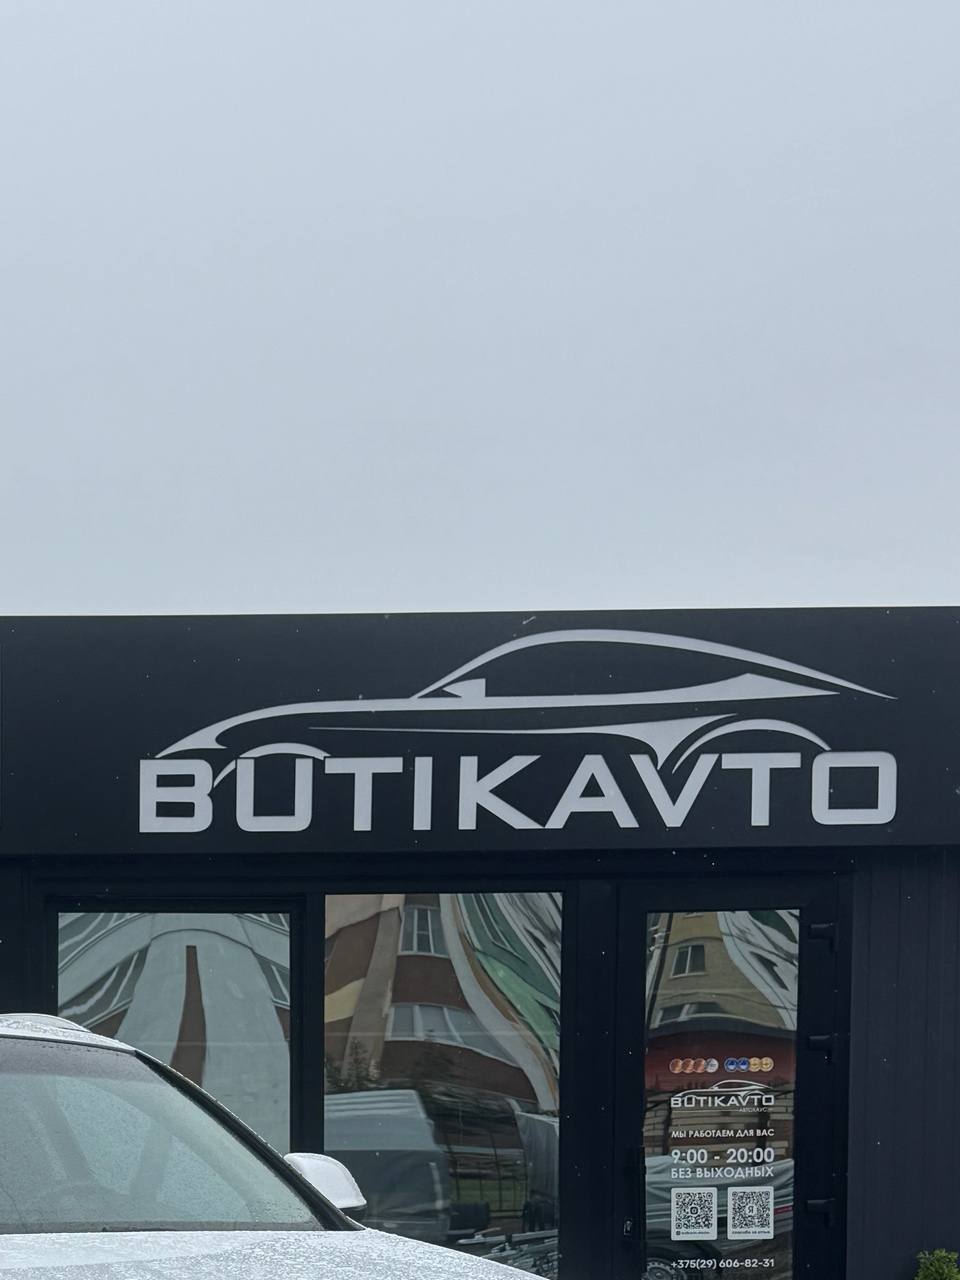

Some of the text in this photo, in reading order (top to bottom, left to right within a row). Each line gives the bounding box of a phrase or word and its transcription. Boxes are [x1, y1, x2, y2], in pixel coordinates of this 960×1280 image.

[139, 750, 898, 833] BUTIKAVTO
[670, 1095, 775, 1108] BUTIKAVTO
[671, 1129, 775, 1138] МЫ РАБОТАЕМ ДЛЯ ВАС
[671, 1149, 708, 1164] 9:00
[726, 1147, 775, 1163] 20:00
[671, 1166, 775, 1179] БЕЗ ВЫХОДНЫХ
[671, 1258, 775, 1269] +375(29) 606-82-31
